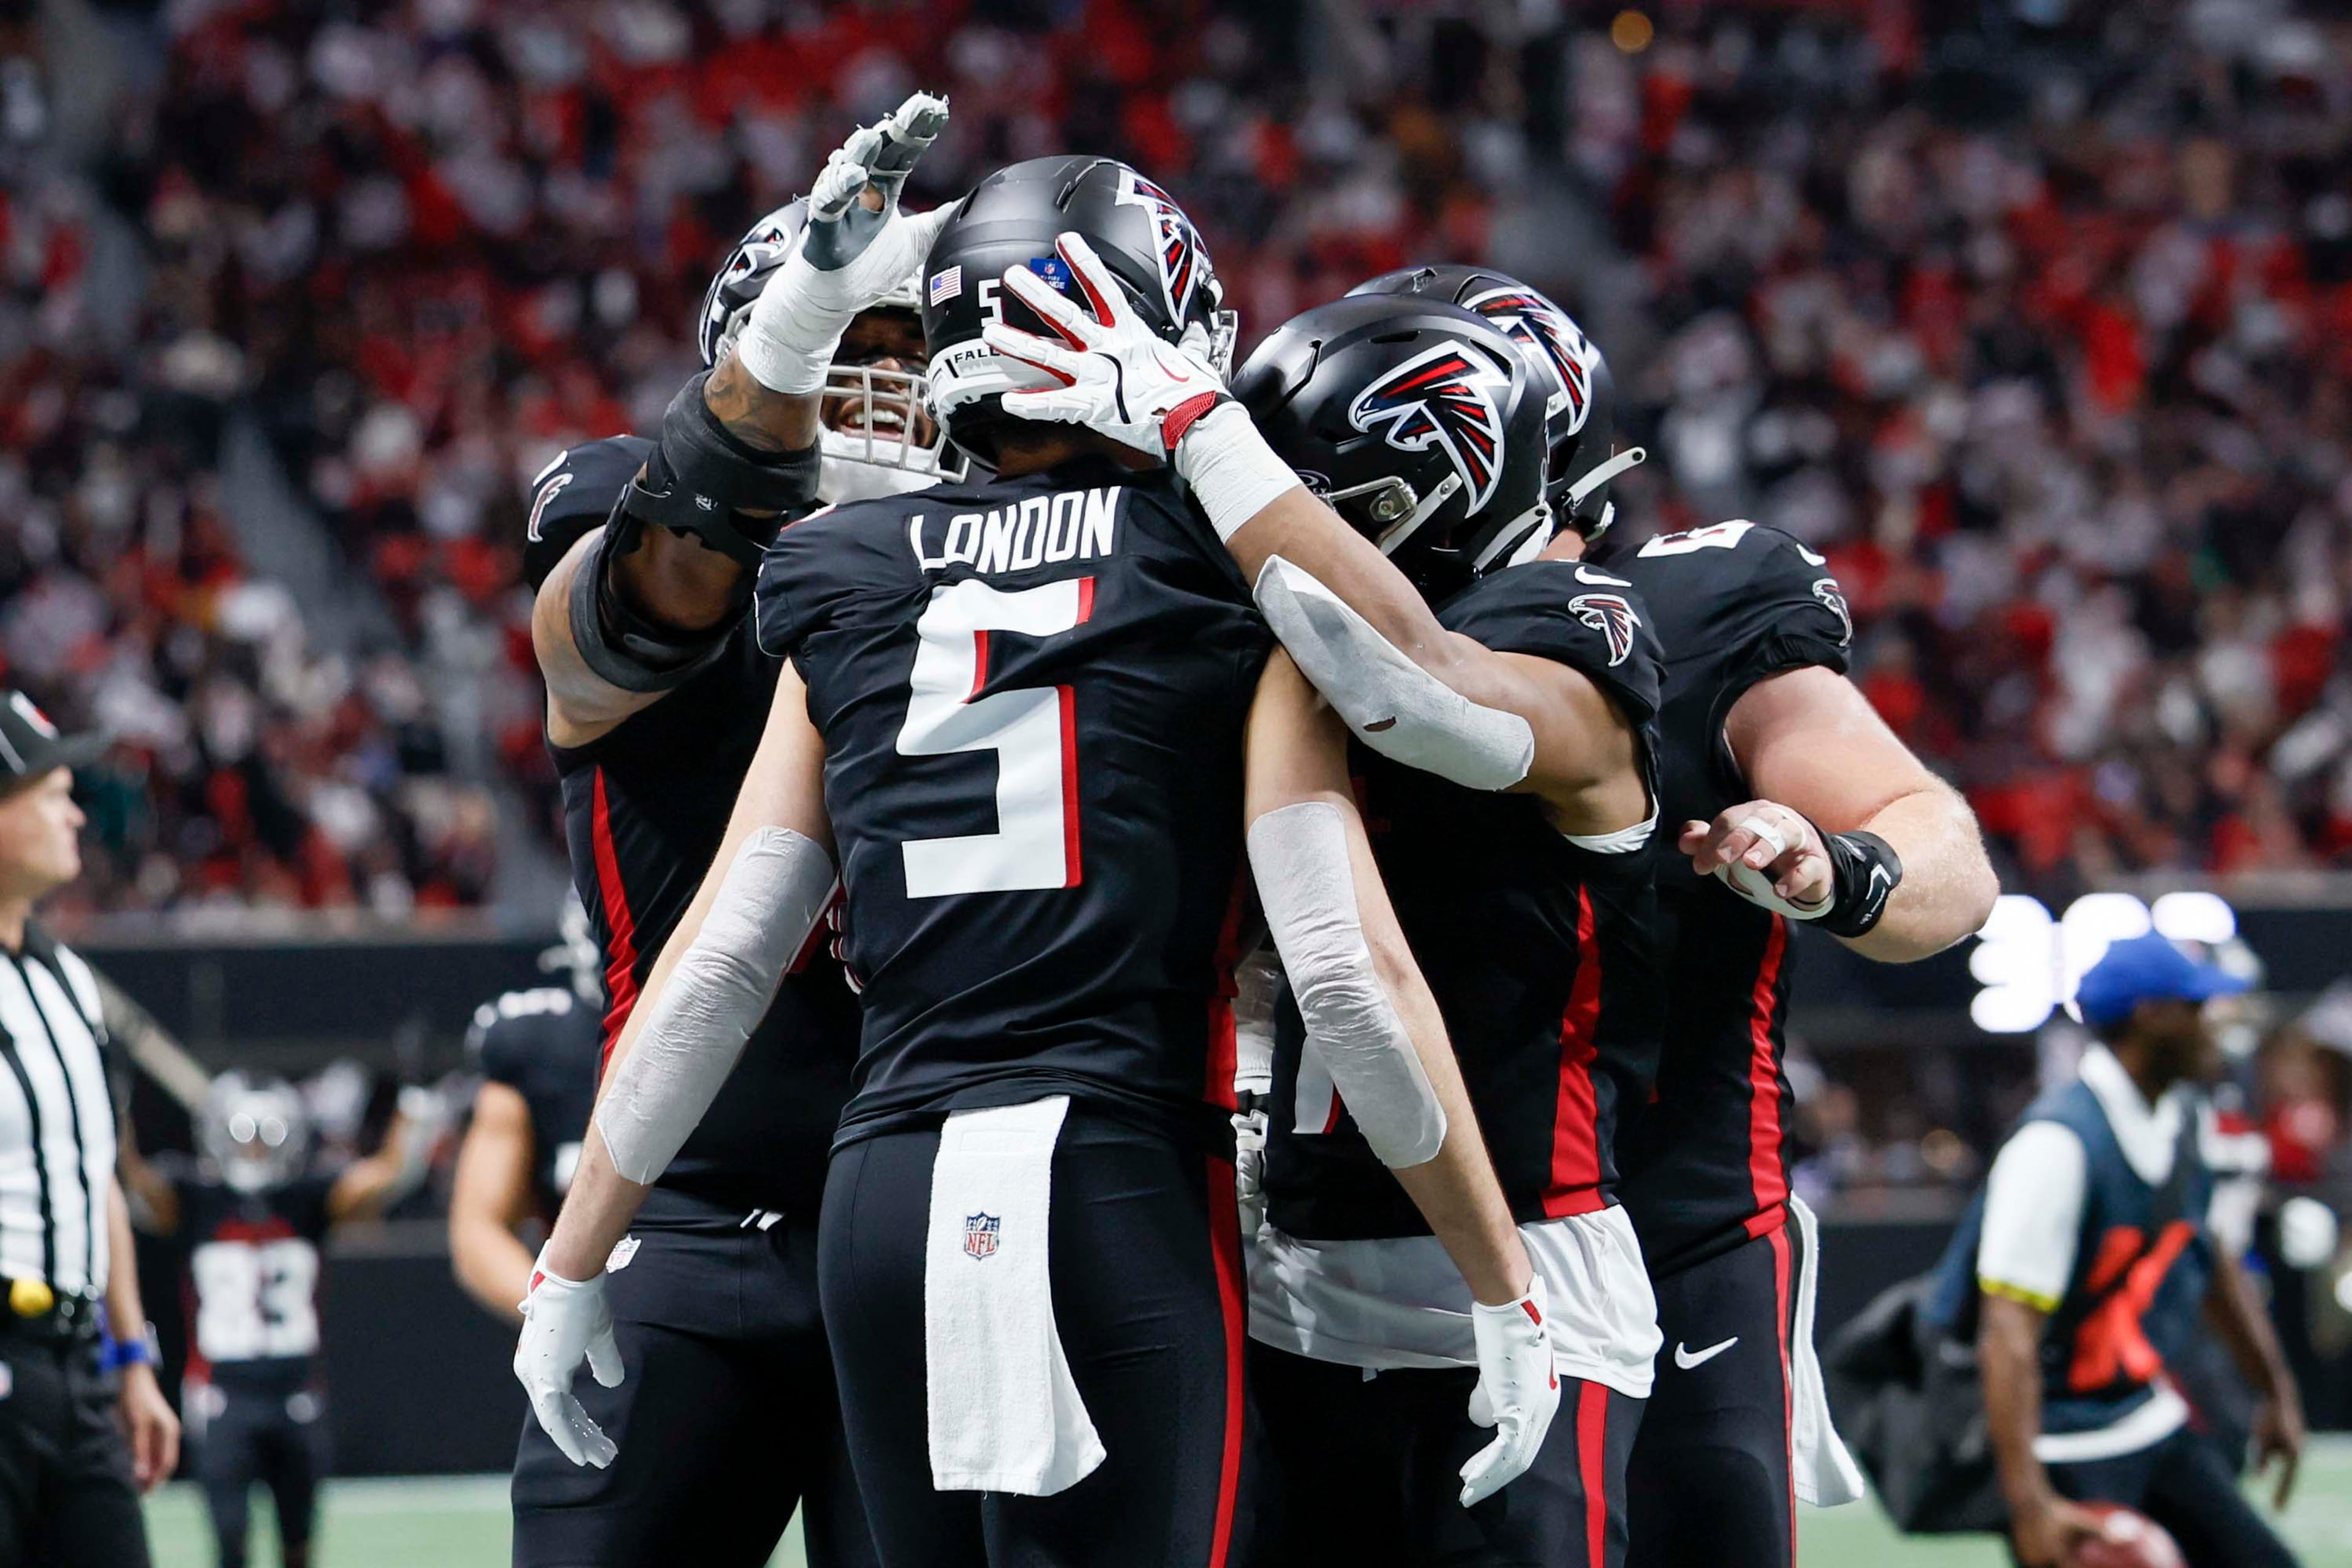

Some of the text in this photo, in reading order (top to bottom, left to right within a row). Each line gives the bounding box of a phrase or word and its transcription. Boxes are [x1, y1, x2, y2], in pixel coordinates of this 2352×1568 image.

[978, 278, 1003, 327] 5
[910, 486, 1121, 575] LONDON
[895, 576, 1095, 899] 5
[967, 1232, 995, 1255] NFL
